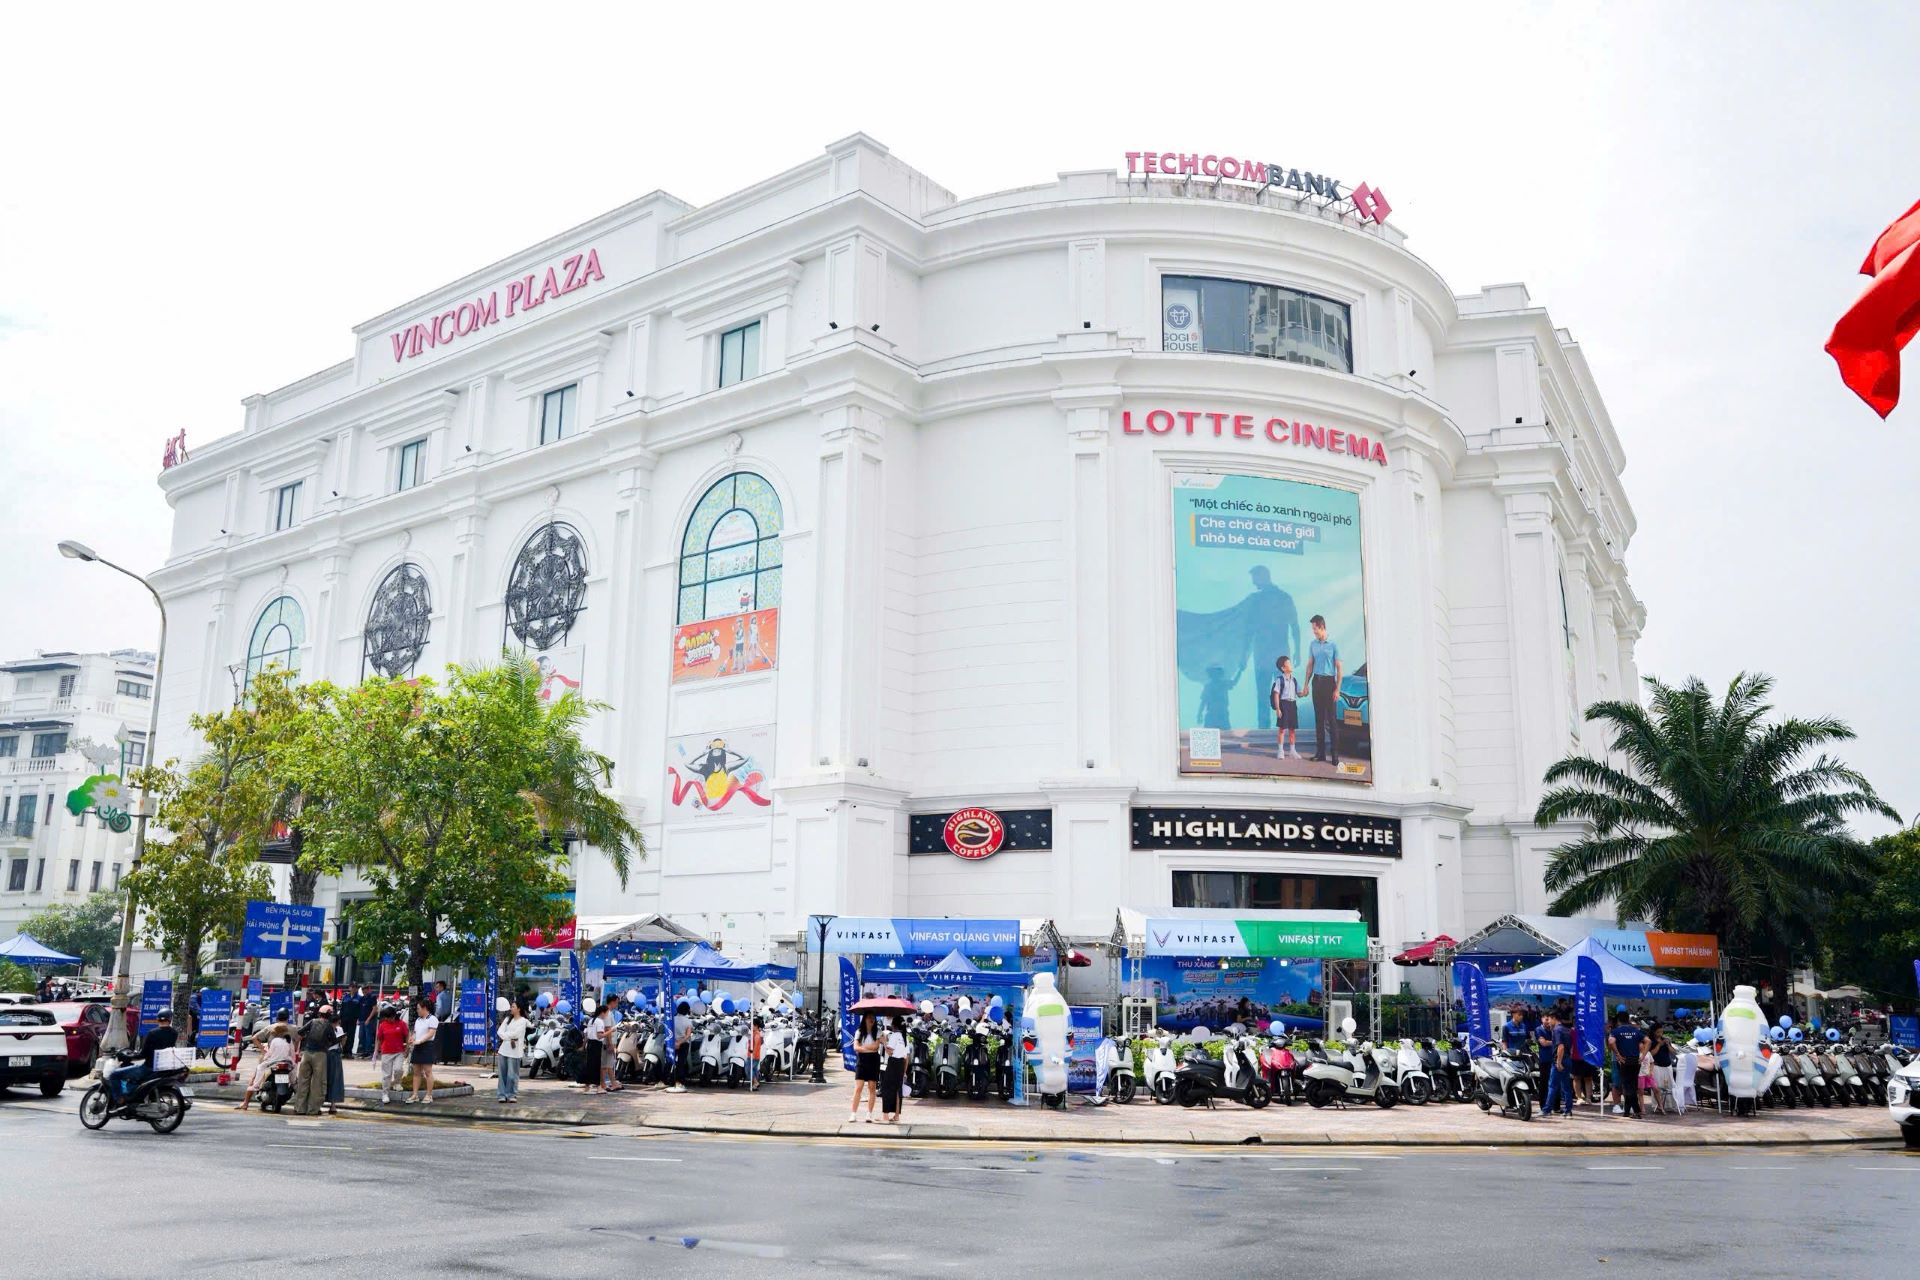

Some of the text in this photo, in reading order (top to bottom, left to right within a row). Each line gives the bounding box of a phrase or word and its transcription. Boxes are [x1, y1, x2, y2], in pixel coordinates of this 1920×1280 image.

[1125, 152, 1343, 201] TECHCOMBANK
[390, 248, 605, 363] VINCOM PLAZA
[1164, 342, 1198, 351] HOUSE
[1122, 409, 1388, 466] LOTTE CINEMA
[1221, 499, 1253, 512] chiếc
[1273, 504, 1301, 517] xanh
[1303, 510, 1331, 523] ngoài
[1333, 514, 1352, 527] phố
[1199, 517, 1226, 529] Che
[1273, 521, 1292, 535] thế
[948, 811, 1000, 833] HIGHLANDS
[1152, 821, 1394, 846] HIGHLANDS COFFEE
[953, 843, 994, 858] COFFEE
[837, 931, 891, 940] VINFAST
[909, 932, 1017, 943] VINFAST QUANG VINH
[1178, 935, 1235, 943] VINFAST
[1278, 934, 1343, 945] VINFAST TKT
[1613, 944, 1646, 952] VINFAST
[1661, 946, 1684, 955] VINFAST
[933, 974, 973, 982] VINFAST
[1470, 977, 1481, 1030] VINFAST
[1578, 974, 1587, 1031] VINFAST
[1589, 995, 1597, 1013] TKT
[463, 1031, 485, 1047] GIÁ CAO
